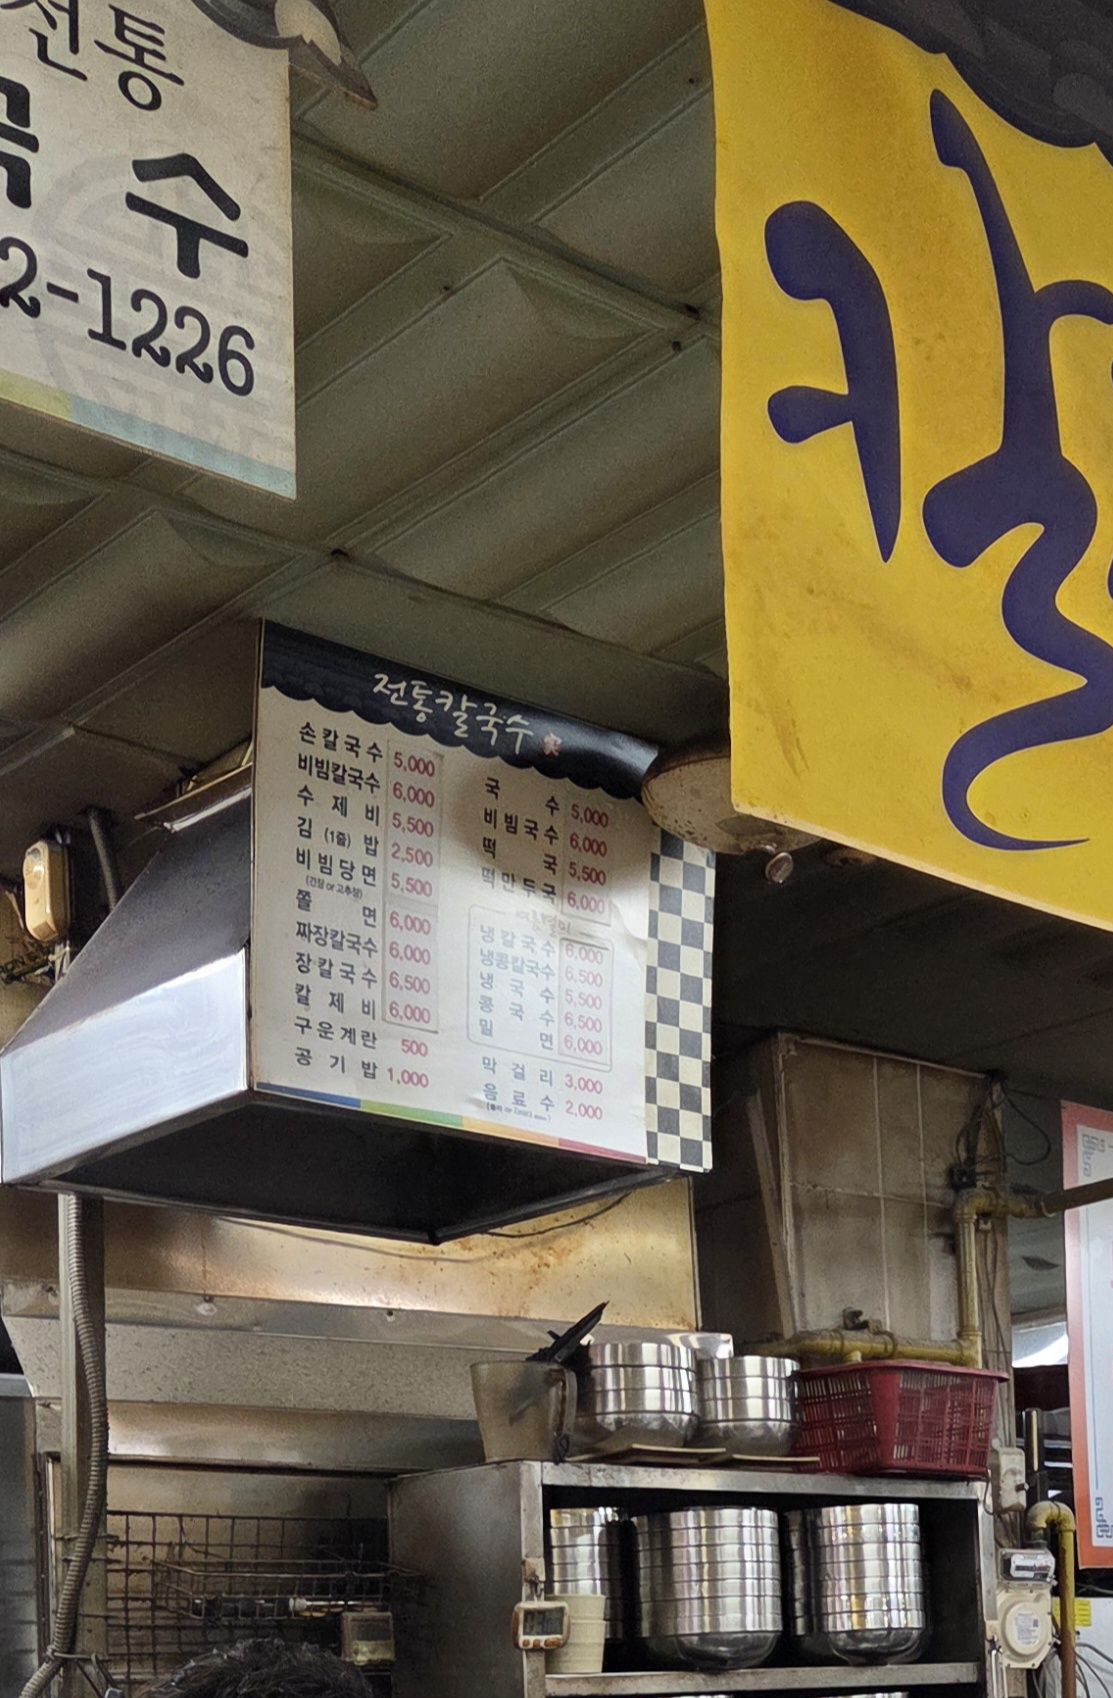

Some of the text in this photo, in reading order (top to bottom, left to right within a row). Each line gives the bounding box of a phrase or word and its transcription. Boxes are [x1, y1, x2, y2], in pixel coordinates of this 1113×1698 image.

[373, 673, 534, 755] 전통칼국수
[299, 721, 435, 777] 손칼국수 5,000
[298, 753, 435, 808] 비빔칼국수 6,000
[392, 812, 434, 837] 5,500
[571, 803, 609, 828] 5,000
[484, 807, 608, 857] 비빔국수 6,000
[391, 842, 433, 868] 2,500
[296, 847, 433, 897] 비빔당면 5,500
[569, 861, 606, 886] 5,500
[481, 866, 605, 913] 떡만두국 6,000
[389, 910, 431, 935] 6,000
[296, 921, 431, 965] 짜장칼국수 6,000
[565, 943, 603, 965] 6,000
[295, 951, 430, 995] 장칼국수 6,500
[565, 965, 603, 987] 6,500
[389, 1000, 431, 1024] 6,000
[565, 989, 602, 1010] 5,500
[564, 1011, 602, 1033] 6,500
[294, 1015, 428, 1057] 구운계란 500
[564, 1034, 602, 1056] 6,000
[387, 1067, 429, 1088] 1,000
[564, 1073, 603, 1095] 3,000
[565, 1100, 603, 1120] 2,000
